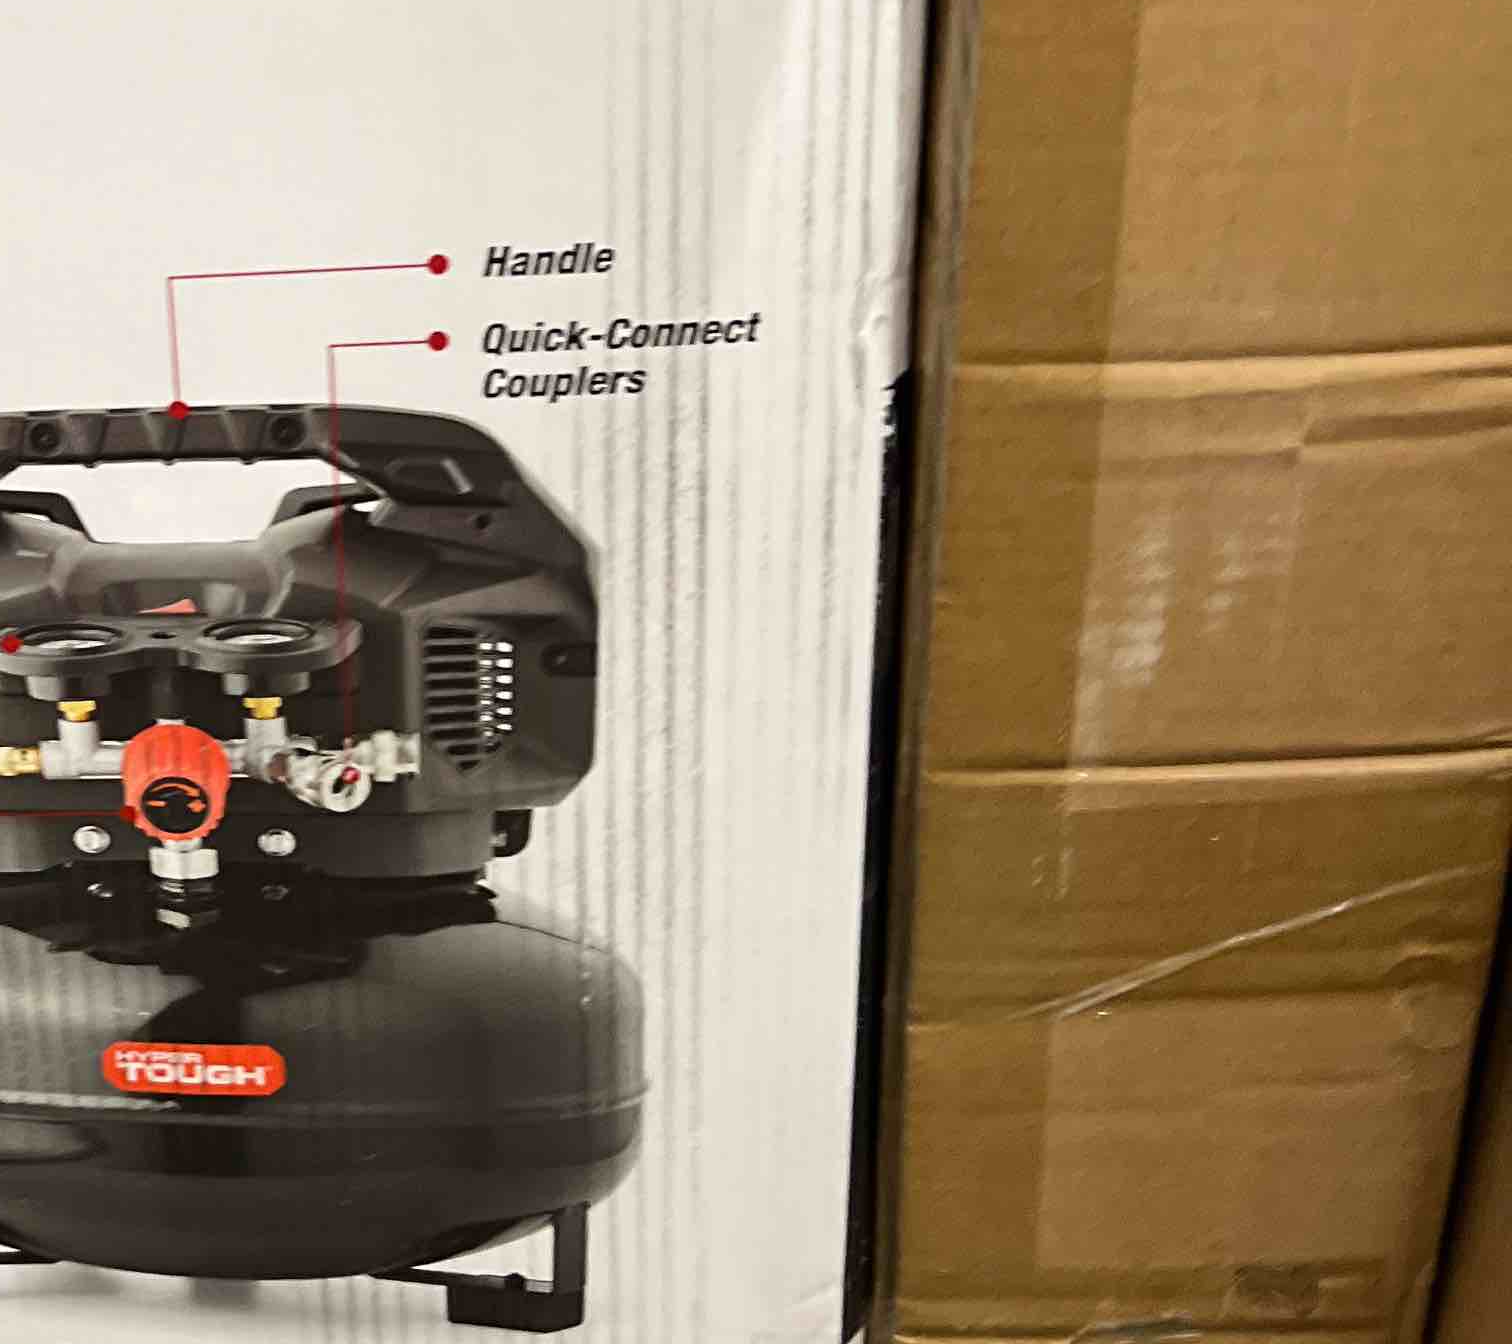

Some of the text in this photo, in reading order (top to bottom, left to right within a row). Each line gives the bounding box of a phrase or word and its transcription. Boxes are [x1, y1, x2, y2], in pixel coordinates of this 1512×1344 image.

[483, 242, 615, 277] Handle
[482, 312, 761, 356] Quick-Connect
[483, 365, 647, 404] Couplers
[115, 1063, 266, 1086] TOUGH
